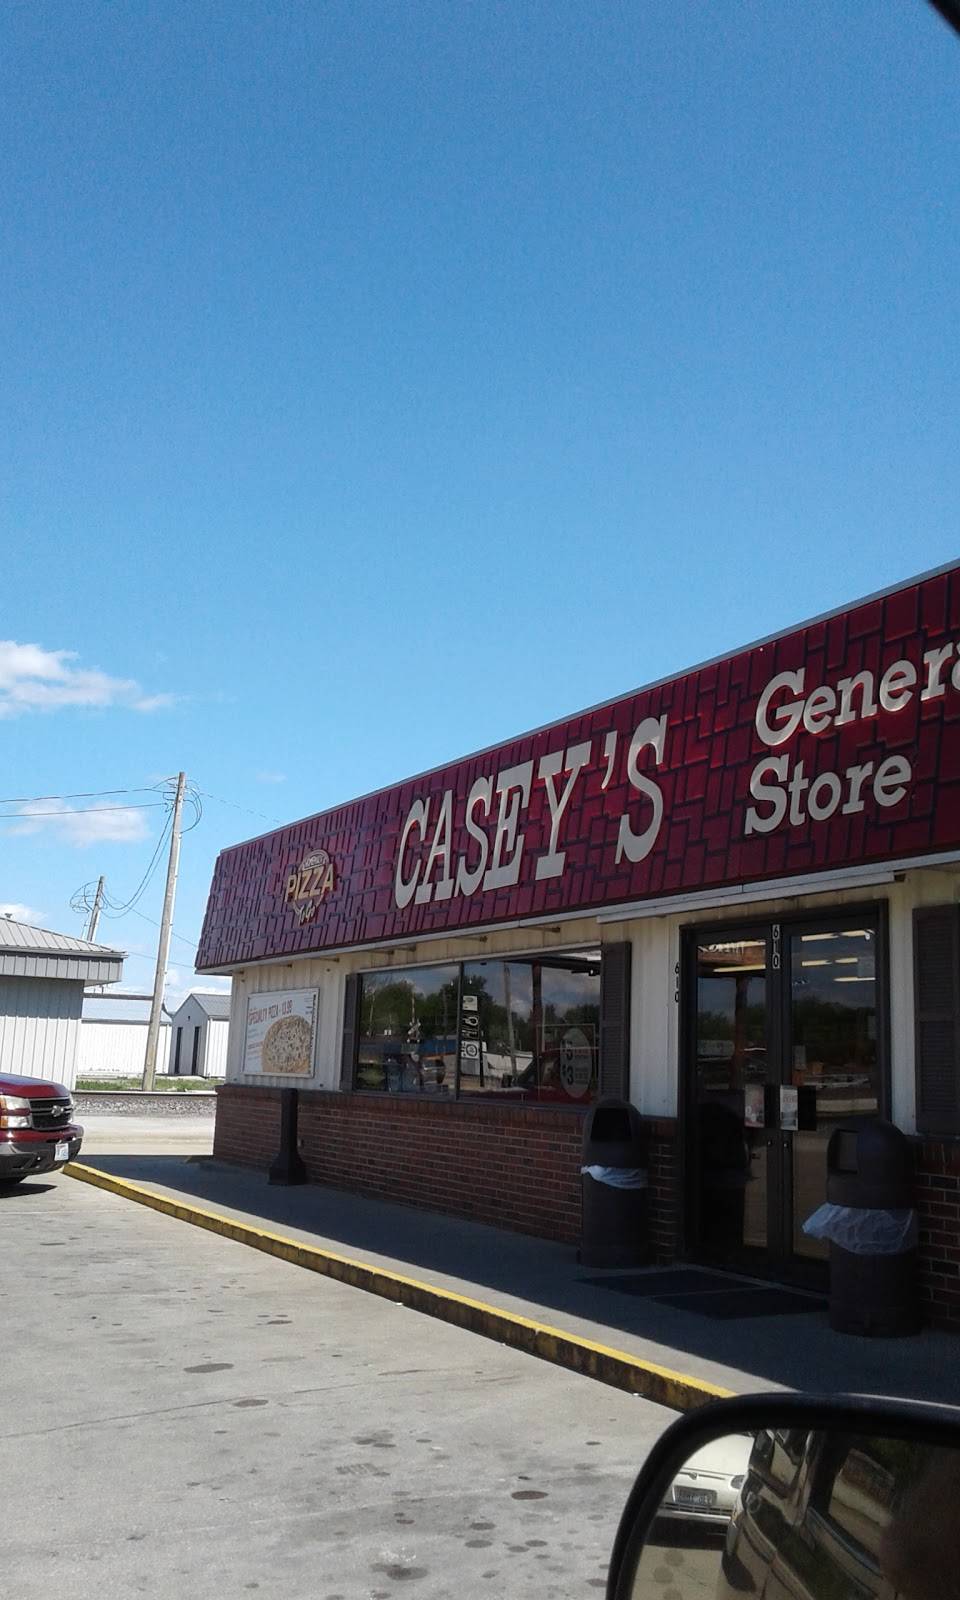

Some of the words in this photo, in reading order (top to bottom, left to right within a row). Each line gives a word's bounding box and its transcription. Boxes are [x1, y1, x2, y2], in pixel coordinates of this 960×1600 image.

[394, 714, 667, 909] CASEY'S
[744, 753, 912, 835] Store
[284, 863, 334, 903] PIZZA
[771, 923, 781, 969] 610
